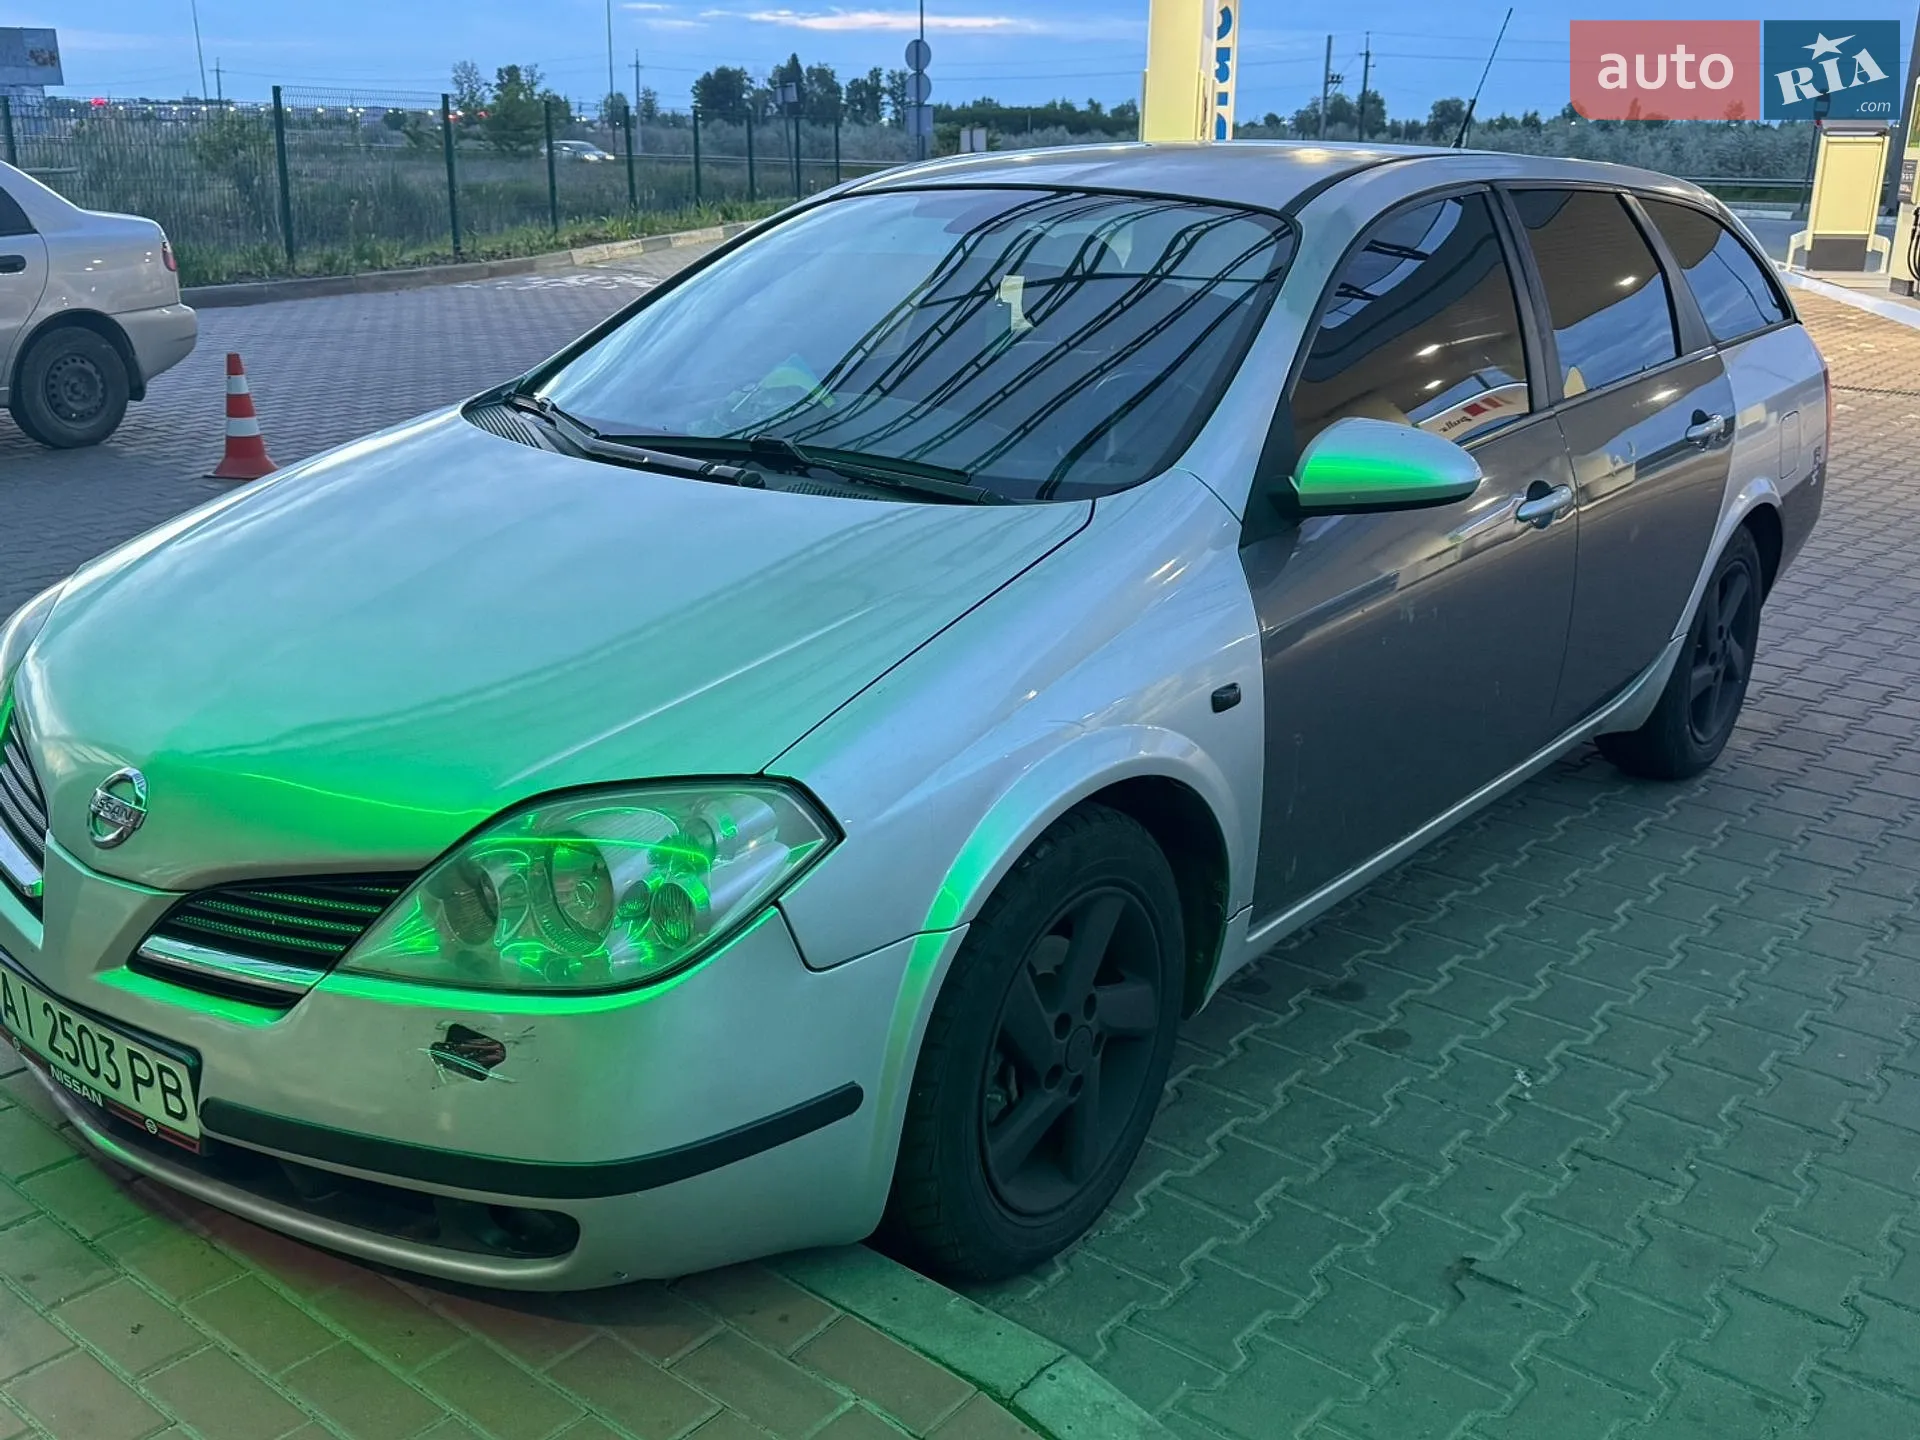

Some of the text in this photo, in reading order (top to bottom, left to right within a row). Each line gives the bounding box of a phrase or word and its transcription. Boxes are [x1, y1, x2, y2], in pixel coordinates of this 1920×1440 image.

[1, 968, 188, 1121] AI 2503 PB
[49, 1064, 104, 1108] NISSAN
